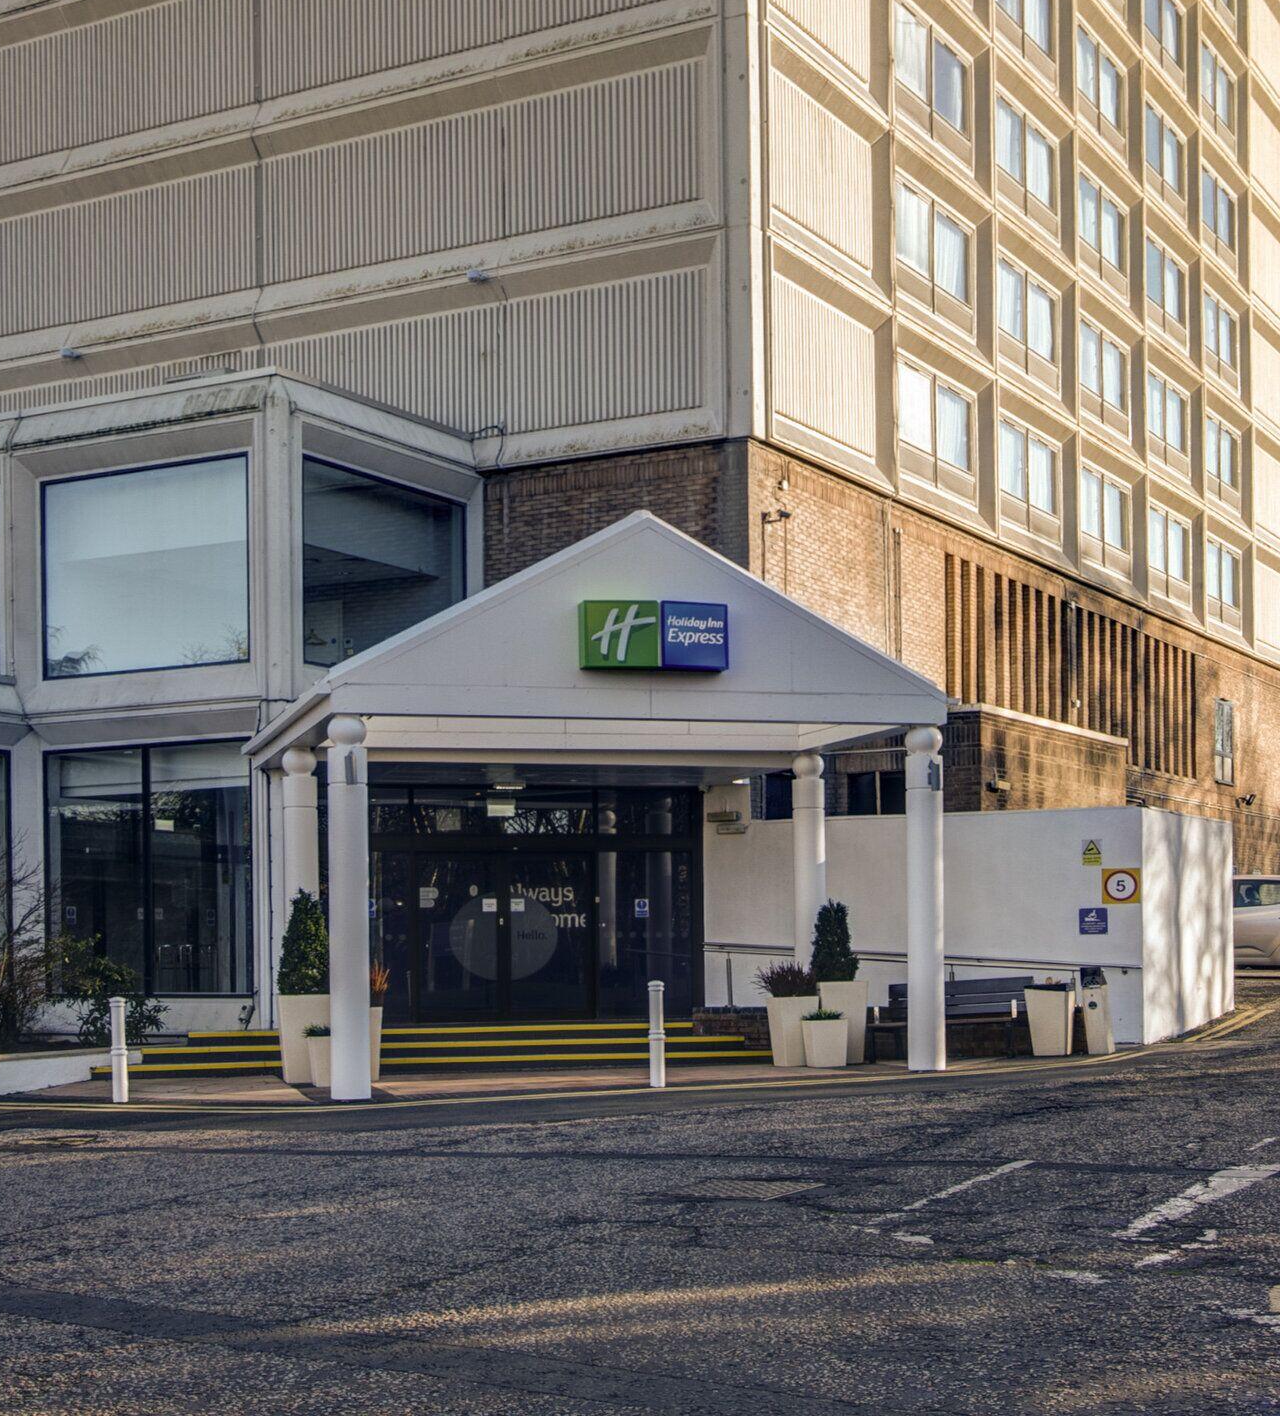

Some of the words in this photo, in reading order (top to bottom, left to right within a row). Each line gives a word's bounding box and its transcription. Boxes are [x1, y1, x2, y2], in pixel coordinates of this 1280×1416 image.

[667, 615, 707, 630] Holiday
[708, 617, 724, 629] Inn
[591, 604, 657, 661] H
[667, 628, 724, 646] Express
[1115, 879, 1126, 892] 5
